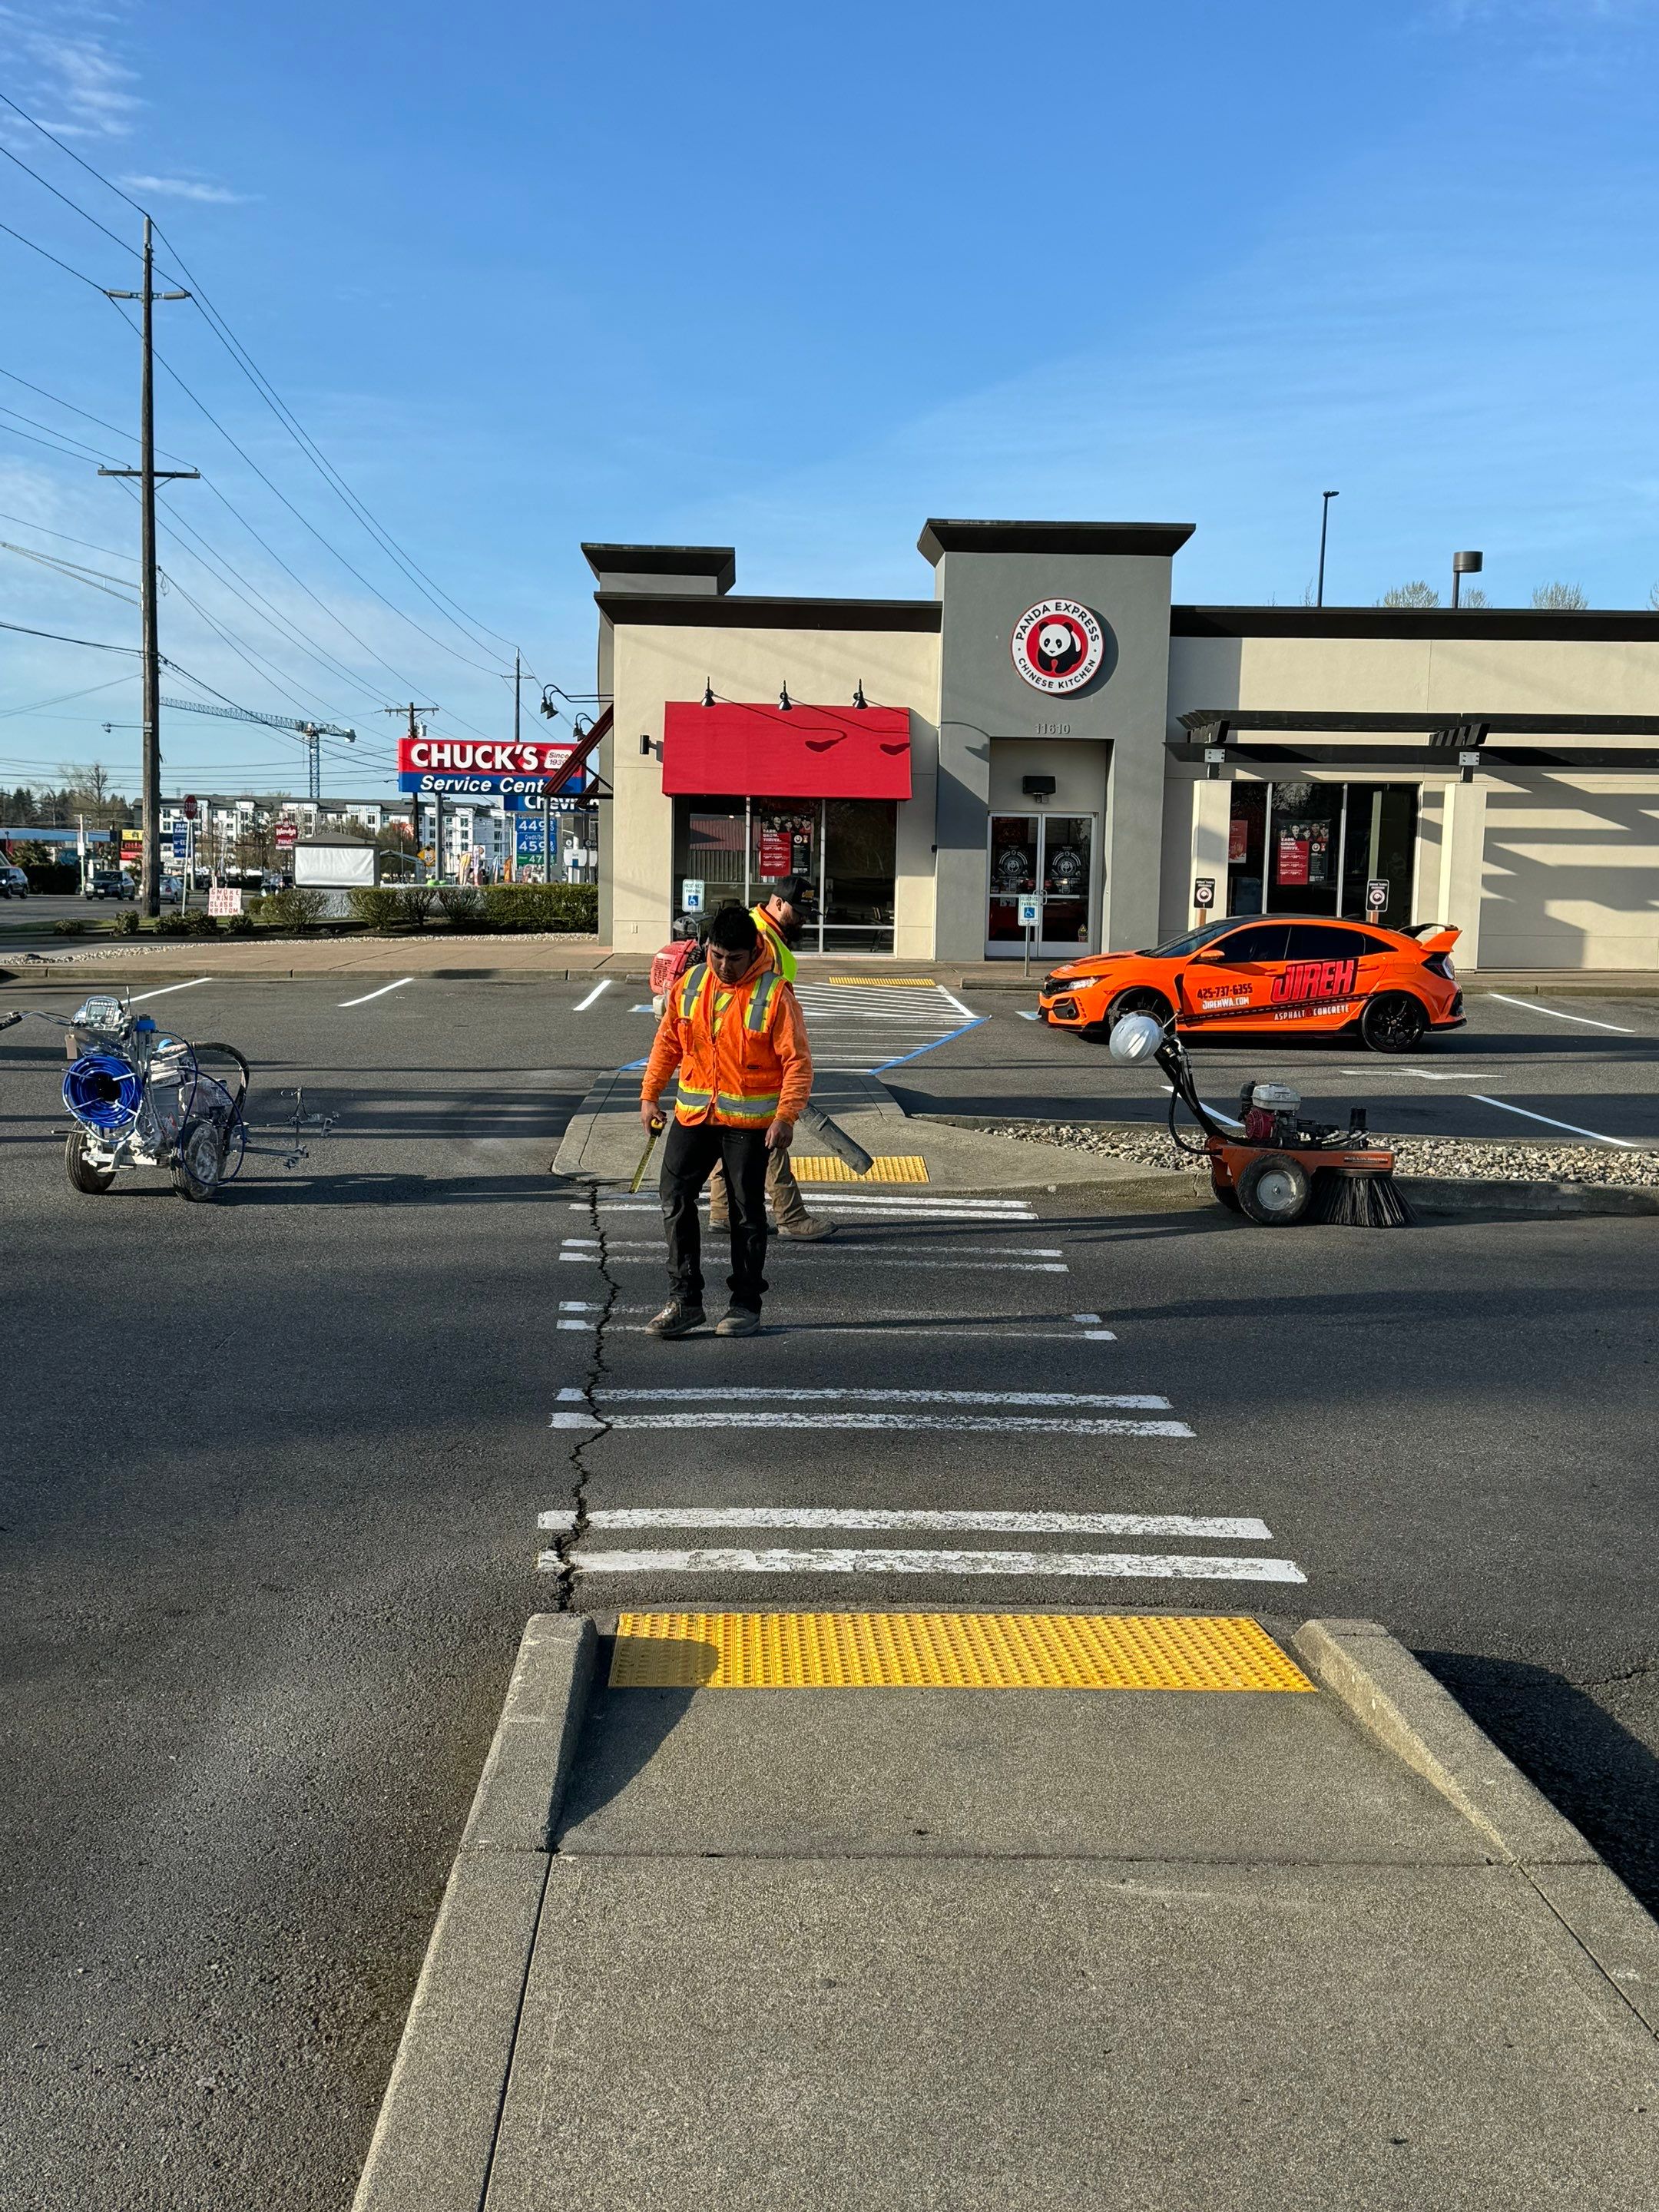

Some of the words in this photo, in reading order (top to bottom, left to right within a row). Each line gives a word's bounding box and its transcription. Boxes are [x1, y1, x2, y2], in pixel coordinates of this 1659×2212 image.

[1015, 604, 1051, 641] PANDA
[1055, 601, 1100, 642] EXPRESS
[1018, 657, 1055, 689] CHINESE
[1058, 659, 1096, 689] KITCHEN
[1035, 724, 1071, 734] 11610
[410, 743, 538, 771] CHUCK'S
[420, 775, 492, 793] Service
[499, 777, 545, 794] Cent
[184, 802, 197, 812] STOP
[524, 795, 599, 811] Chevrn
[518, 820, 546, 831] 449
[518, 841, 546, 852] 459
[1272, 959, 1356, 1003] JIREH
[1197, 983, 1253, 999] 425-737-6355
[1274, 1010, 1305, 1021] ASPHALT
[1313, 1005, 1349, 1016] CONCRETE
